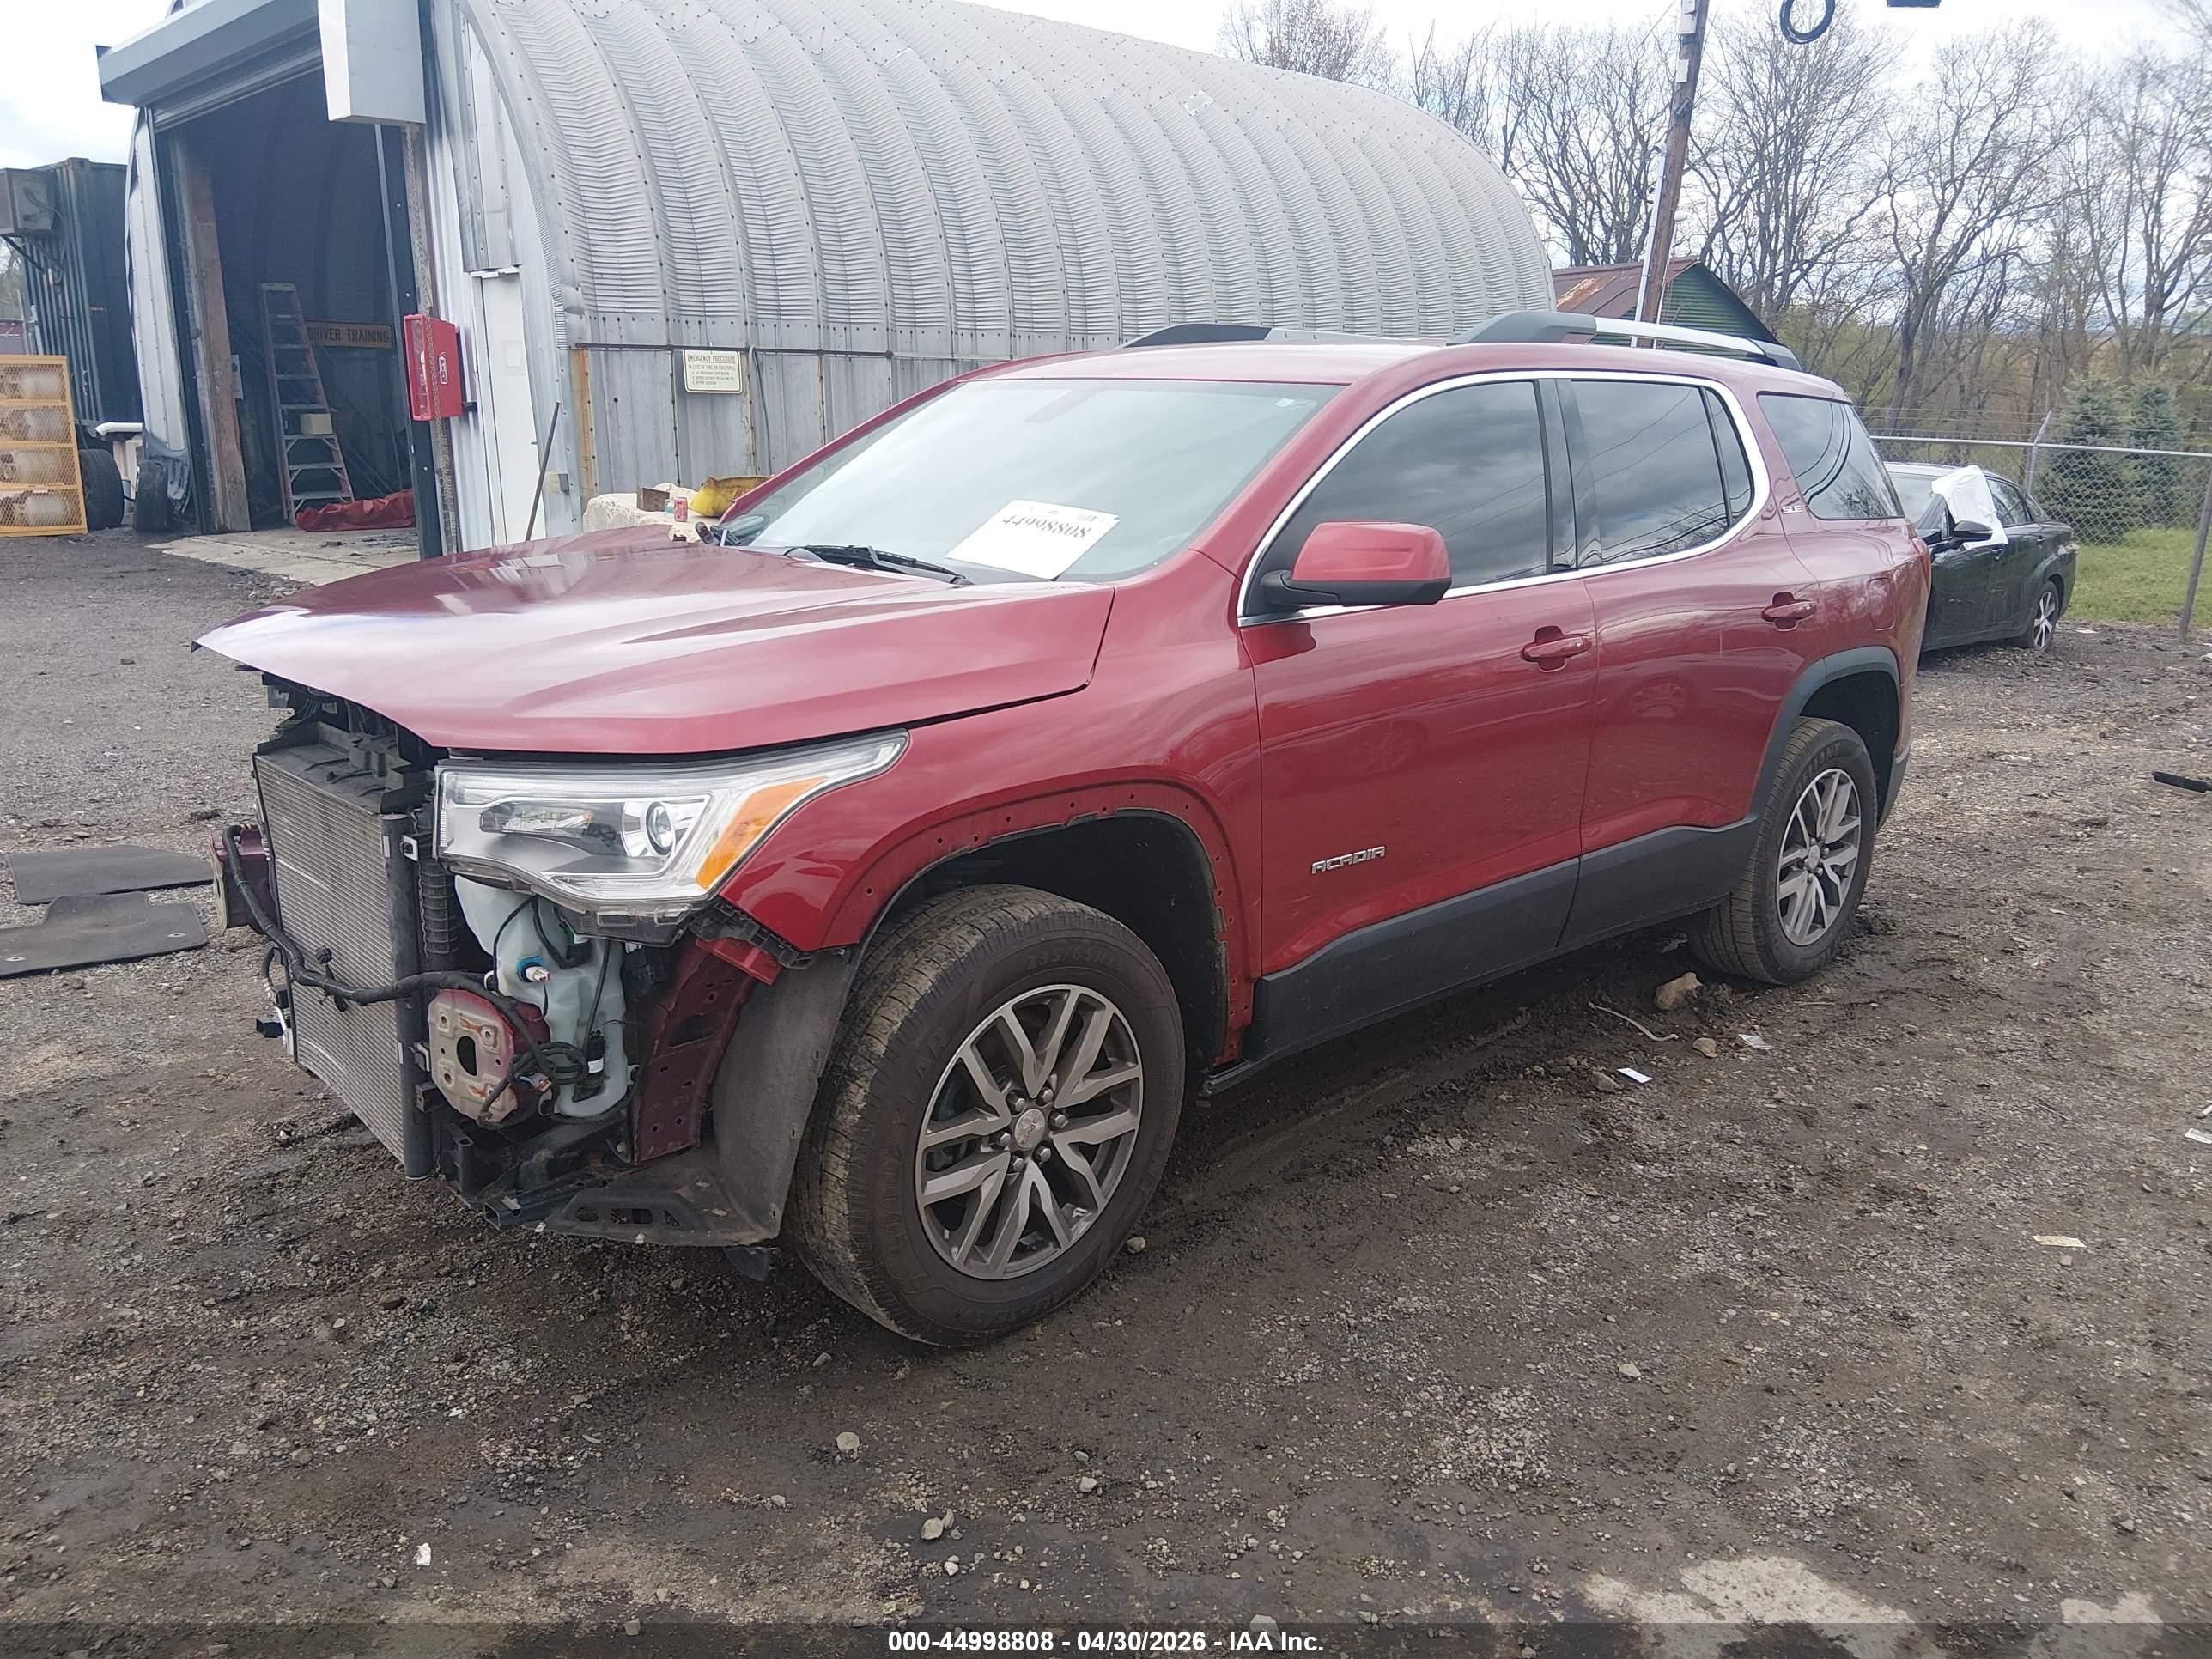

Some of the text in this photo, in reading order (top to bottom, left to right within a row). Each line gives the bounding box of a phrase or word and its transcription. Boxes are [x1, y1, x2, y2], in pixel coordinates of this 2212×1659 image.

[307, 327, 389, 343] DRIVER TRAINING
[1782, 505, 1803, 514] SLE
[1002, 514, 1091, 538] 44998808
[1312, 846, 1385, 874] ACADIA
